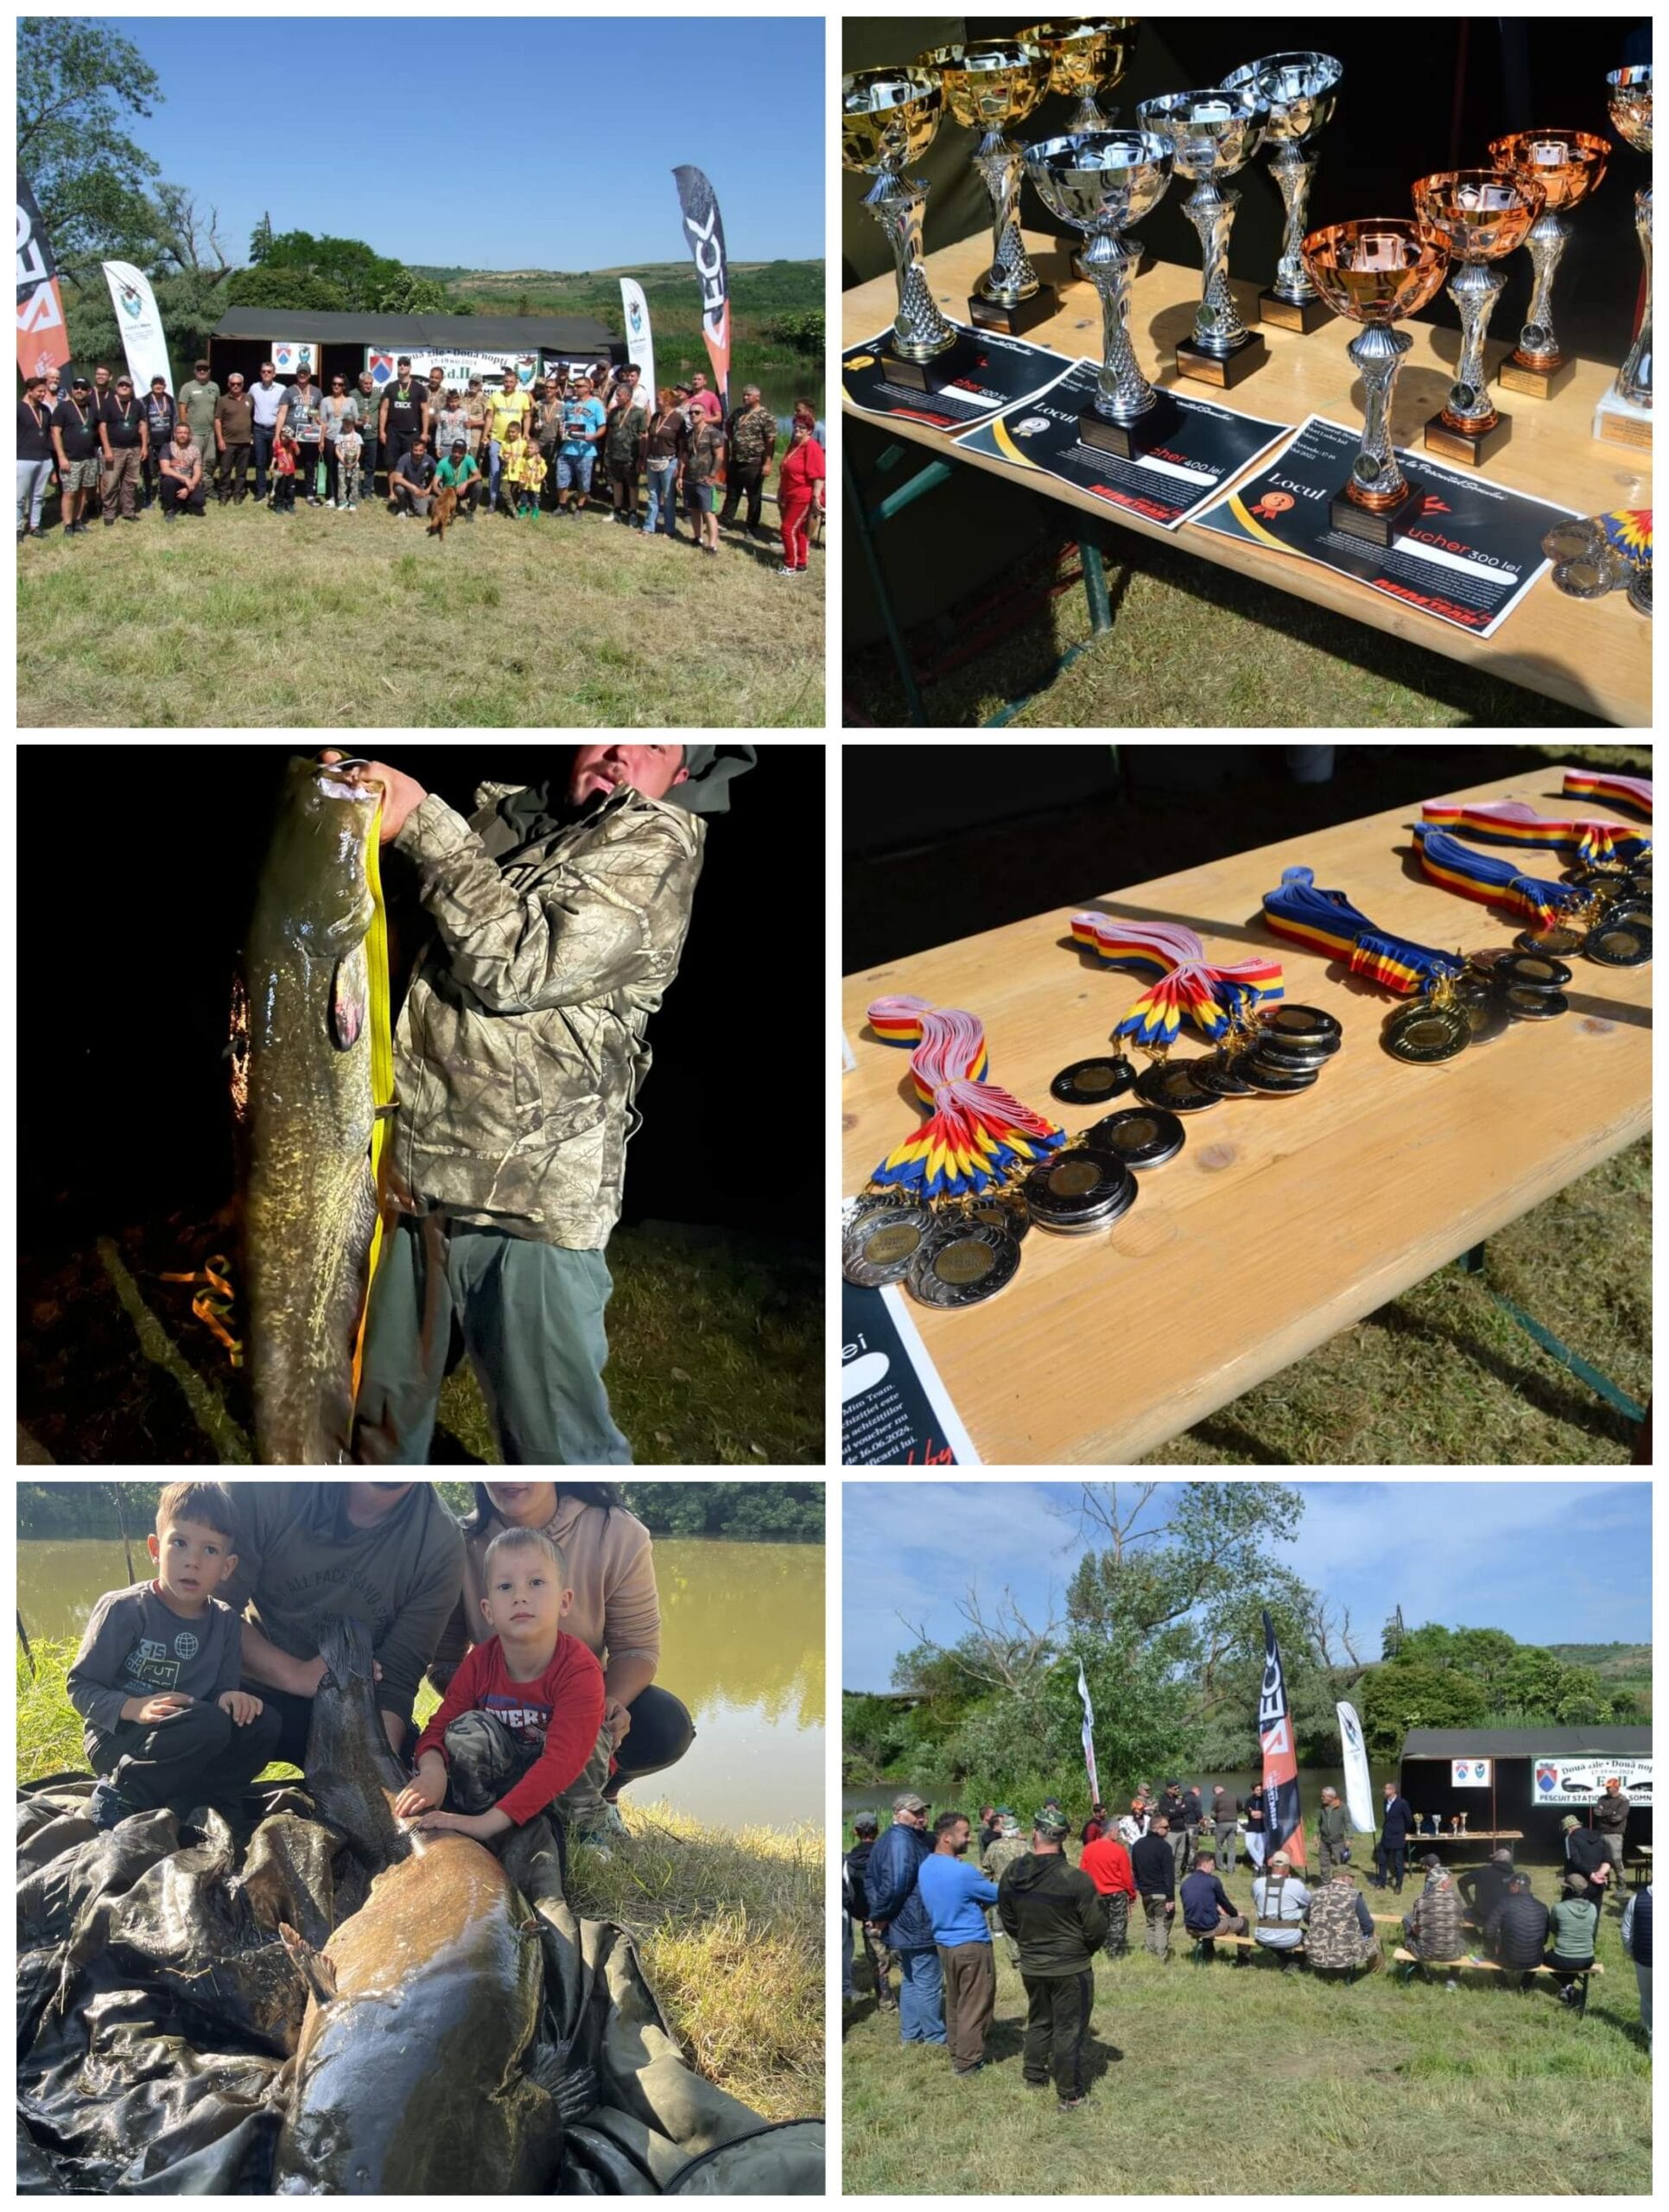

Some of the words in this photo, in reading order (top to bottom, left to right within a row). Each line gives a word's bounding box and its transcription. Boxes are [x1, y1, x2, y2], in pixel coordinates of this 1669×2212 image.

[1032, 402, 1079, 423] Locul
[1184, 459, 1208, 472] 400
[1267, 473, 1328, 500] Locul
[1408, 527, 1471, 554] ucher
[1468, 550, 1500, 567] 300
[1501, 561, 1522, 573] lei
[842, 1333, 867, 1359] ei
[842, 1400, 865, 1416] Mim
[866, 1383, 896, 1402] Team.
[880, 1392, 899, 1407] este
[853, 1422, 893, 1448] voucher
[894, 1413, 909, 1425] nu
[143, 1665, 175, 1678] FUT
[485, 1707, 548, 1727] VER!
[1638, 1763, 1653, 1774] nop
[1572, 1795, 1598, 1804] STAȚIO
